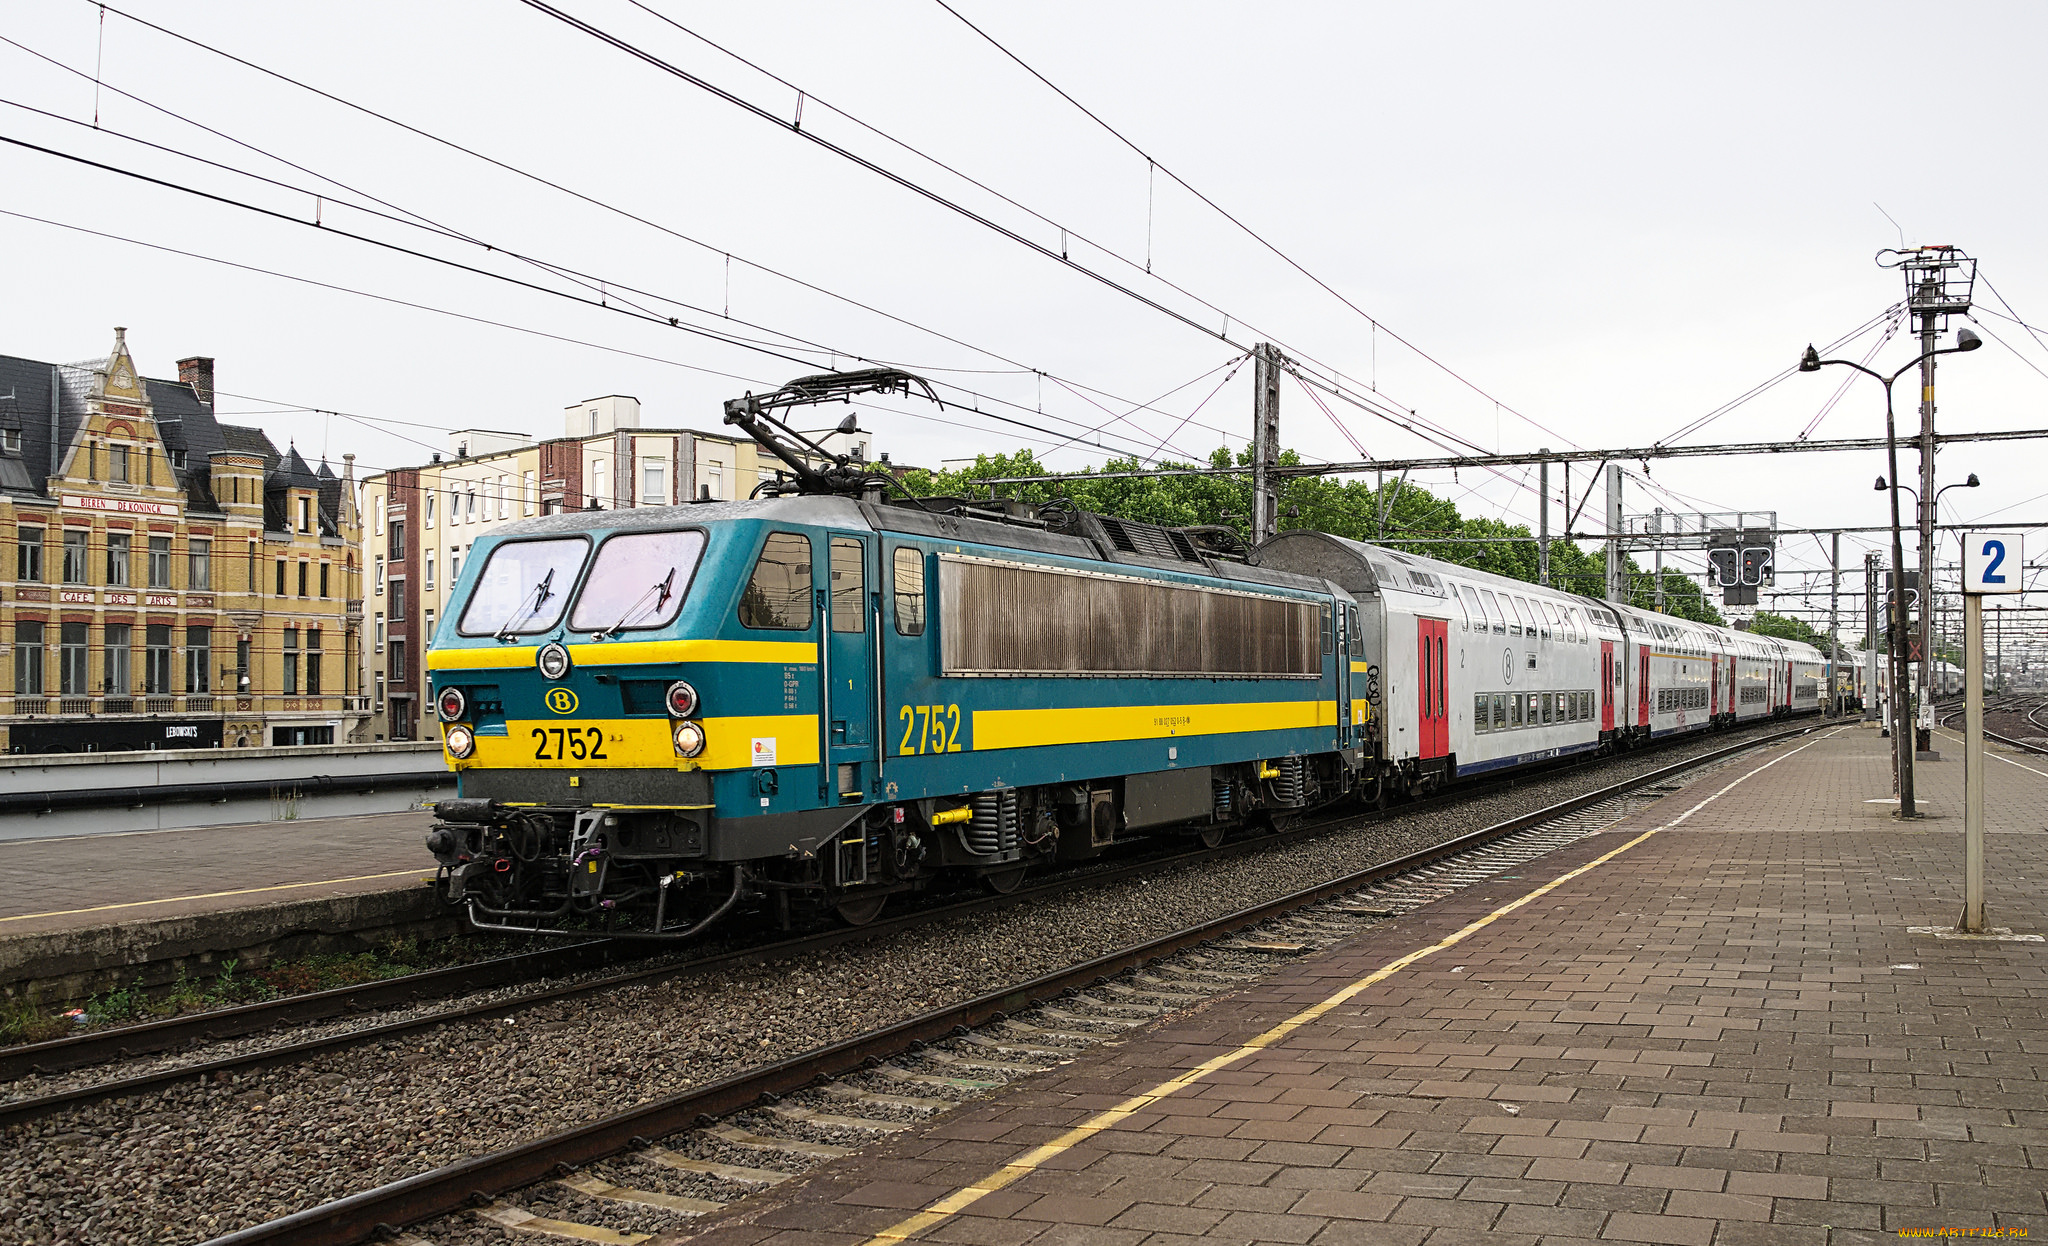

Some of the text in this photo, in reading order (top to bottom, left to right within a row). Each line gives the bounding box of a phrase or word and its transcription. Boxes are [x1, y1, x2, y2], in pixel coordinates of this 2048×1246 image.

[81, 498, 162, 513] BIEREN DE KONINCK
[1981, 539, 2006, 584] 2
[112, 594, 128, 604] DES
[150, 596, 172, 605] ARTS
[1460, 648, 1465, 669] 2
[848, 679, 853, 690] 1
[553, 691, 572, 711] B
[165, 725, 198, 738] LEBOWSKI'S
[899, 703, 962, 756] 2752
[531, 727, 608, 760] 2752
